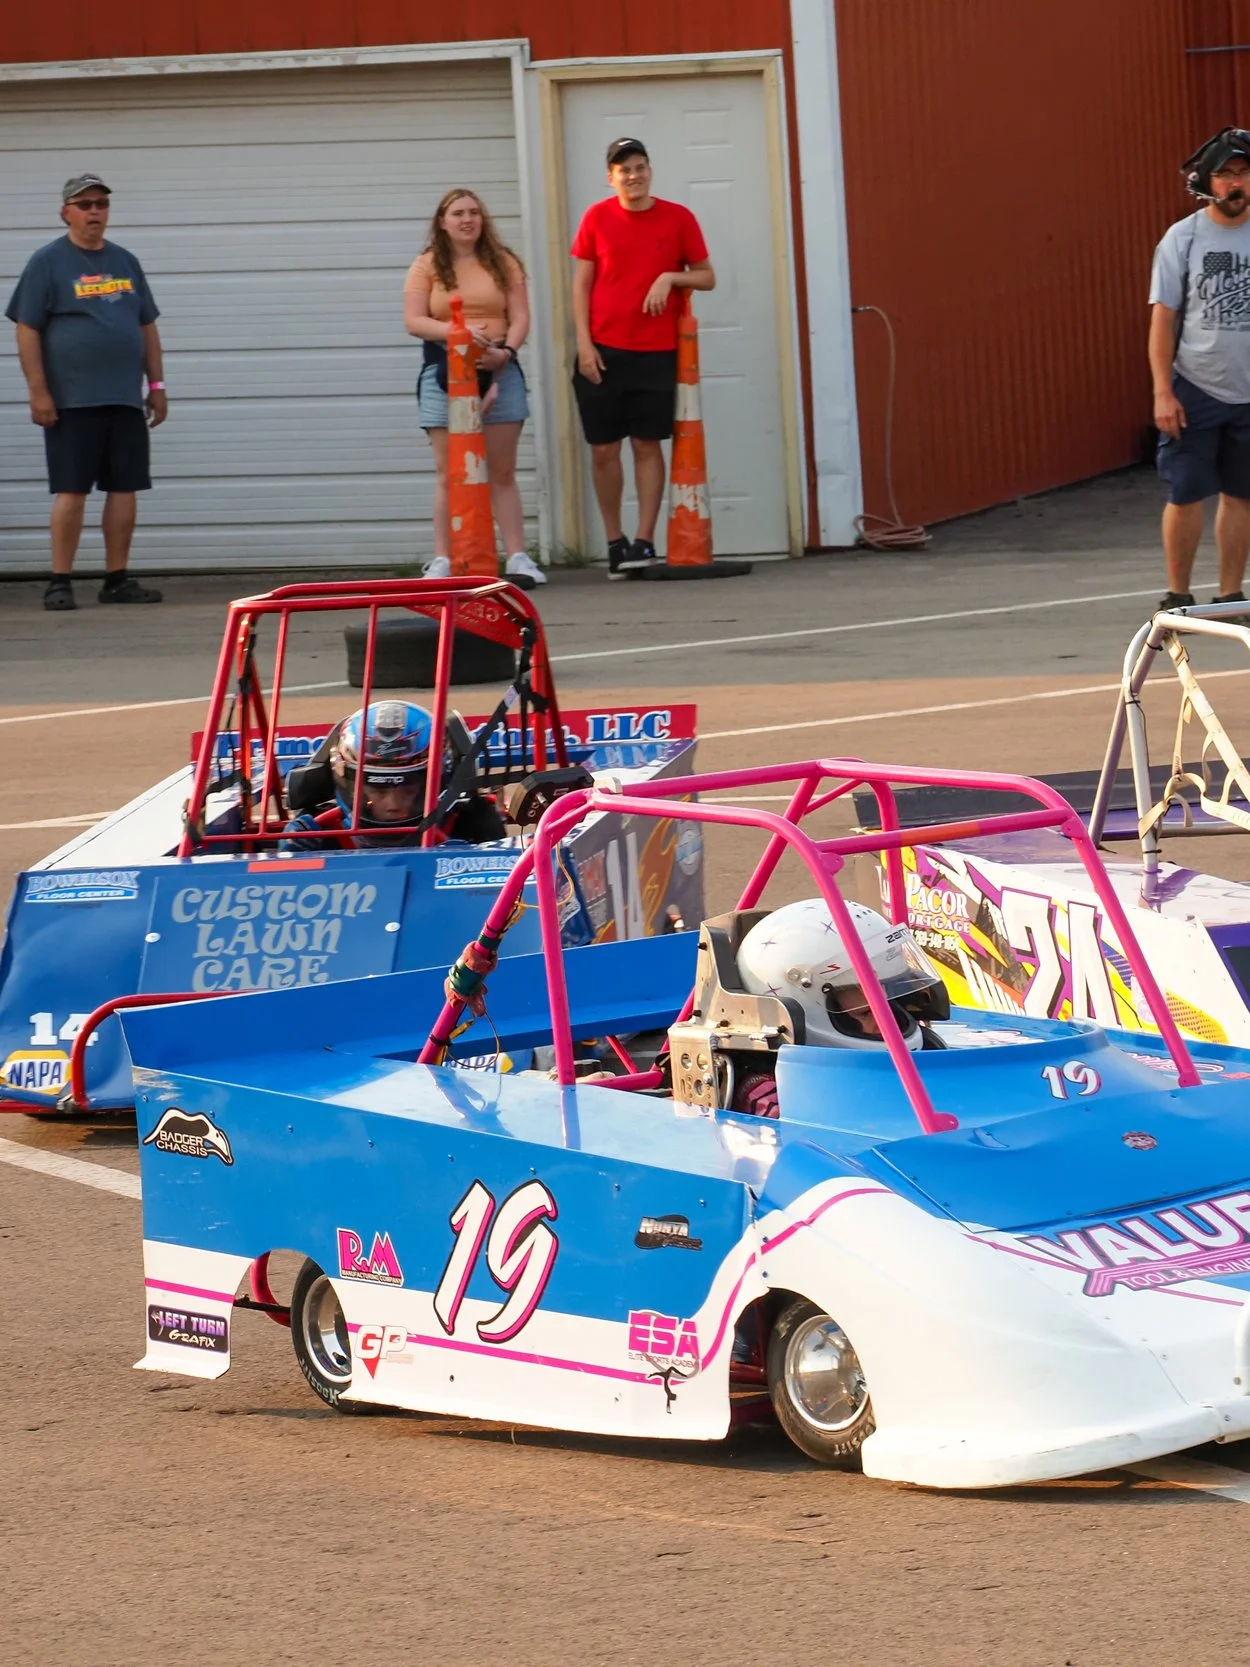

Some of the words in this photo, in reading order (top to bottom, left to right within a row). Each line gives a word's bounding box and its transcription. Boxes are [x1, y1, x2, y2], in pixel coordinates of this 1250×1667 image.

[585, 710, 671, 745] LLC
[435, 856, 521, 878] BOWERS
[446, 876, 485, 885] FLOOR
[26, 871, 141, 894] BOWERSOX
[36, 891, 74, 900] FLOOR
[77, 890, 125, 898] CENTER
[906, 872, 970, 919] PACOR
[172, 882, 377, 923] CUSTOM
[908, 913, 970, 933] ORTGAGE
[192, 918, 342, 958] LAWN
[191, 955, 329, 992] CARE
[29, 1012, 98, 1046] 14
[9, 1061, 63, 1088] NAPA
[1041, 1060, 1102, 1100] 19
[156, 1141, 208, 1156] CHASSIS
[160, 1130, 204, 1147] BADGER
[433, 1178, 558, 1344] 19
[159, 1311, 187, 1329] LEFT
[190, 1316, 225, 1336] TURN
[628, 1311, 699, 1358] ESA
[168, 1329, 216, 1348] GRAFIX
